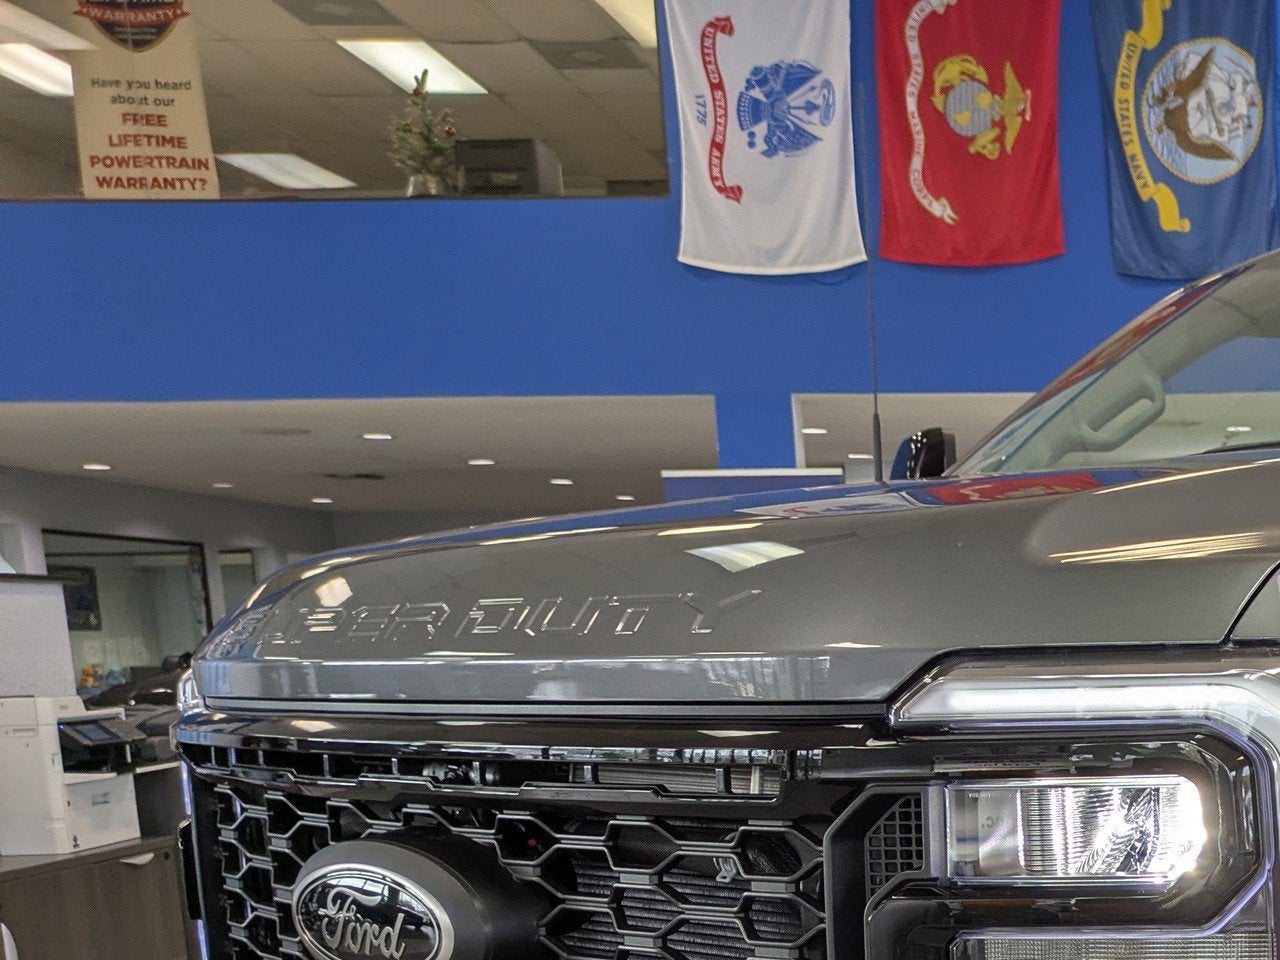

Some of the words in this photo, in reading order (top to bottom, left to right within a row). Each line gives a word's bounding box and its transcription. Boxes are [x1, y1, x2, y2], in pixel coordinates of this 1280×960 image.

[702, 26, 720, 83] UNITED
[1119, 42, 1138, 90] UNITED
[91, 78, 122, 90] Have
[126, 80, 151, 91] you
[155, 79, 192, 91] heard
[111, 94, 149, 106] about
[153, 96, 176, 106] our
[694, 94, 708, 127] 1775
[121, 112, 168, 127] FREE
[1118, 98, 1134, 147] STATES
[108, 134, 188, 149] LIFETIME
[89, 155, 210, 171] POWERTRAIN
[1127, 153, 1149, 190] NAVY
[96, 175, 208, 191] WARRANTY?
[317, 886, 406, 960] Ford
